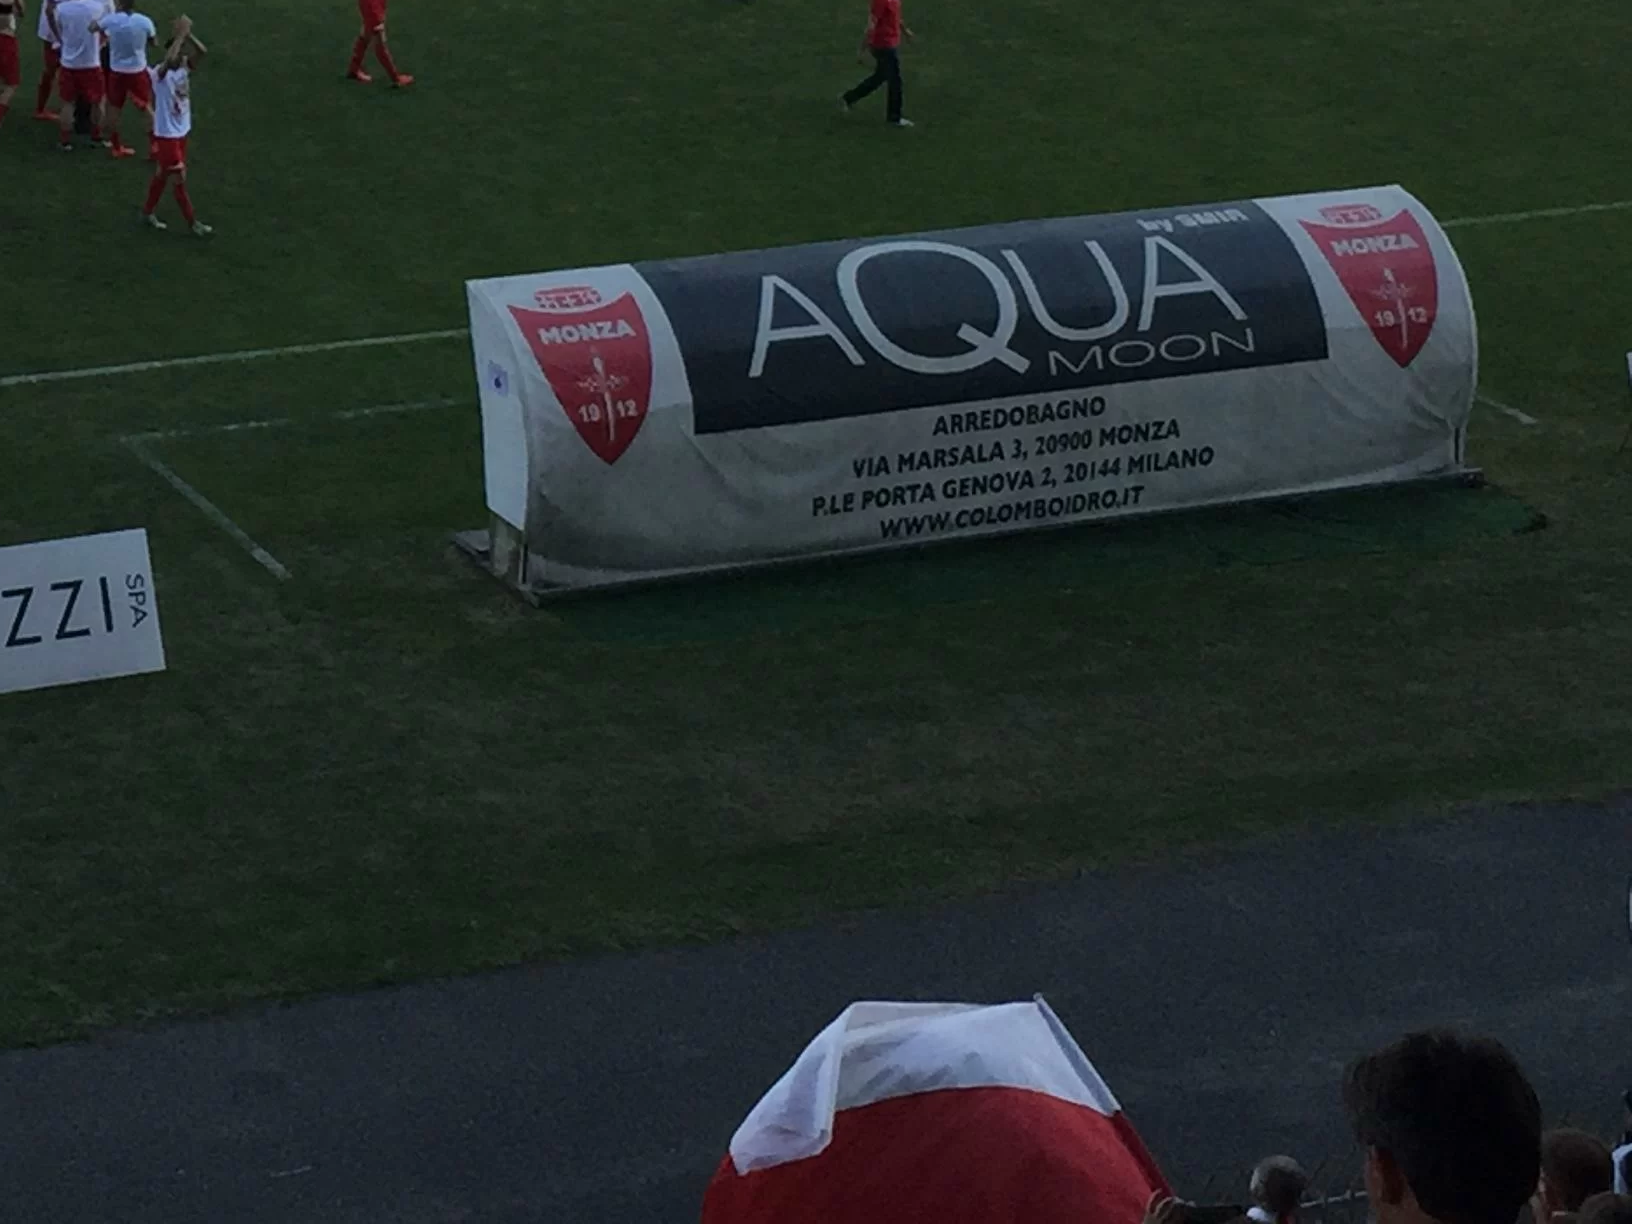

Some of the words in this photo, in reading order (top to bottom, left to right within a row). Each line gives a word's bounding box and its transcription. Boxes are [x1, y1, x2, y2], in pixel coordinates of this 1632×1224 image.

[1329, 232, 1421, 257] MONZA
[748, 234, 1249, 378] AQUA
[1374, 309, 1396, 328] 19
[1407, 307, 1429, 324] 12
[536, 319, 637, 345] MONZA
[1049, 327, 1255, 377] MOON
[578, 403, 602, 423] 19
[616, 399, 639, 418] 12
[932, 395, 1107, 437] ARREDOBAGNO
[852, 457, 891, 479] VIA
[897, 439, 1006, 474] MARSALA
[1011, 438, 1029, 462] 3,
[1034, 428, 1093, 456] 20900
[1099, 417, 1181, 447] MONZA
[811, 490, 855, 517] P.LE
[861, 481, 937, 512] PORTA
[942, 467, 1035, 501] GENOVA
[1040, 465, 1058, 489] 2,
[1063, 457, 1122, 484] 20144
[1127, 445, 1215, 476] MILANO
[880, 484, 1145, 539] WWW.COLOMBOIDRO.IT
[124, 572, 149, 629] SPA
